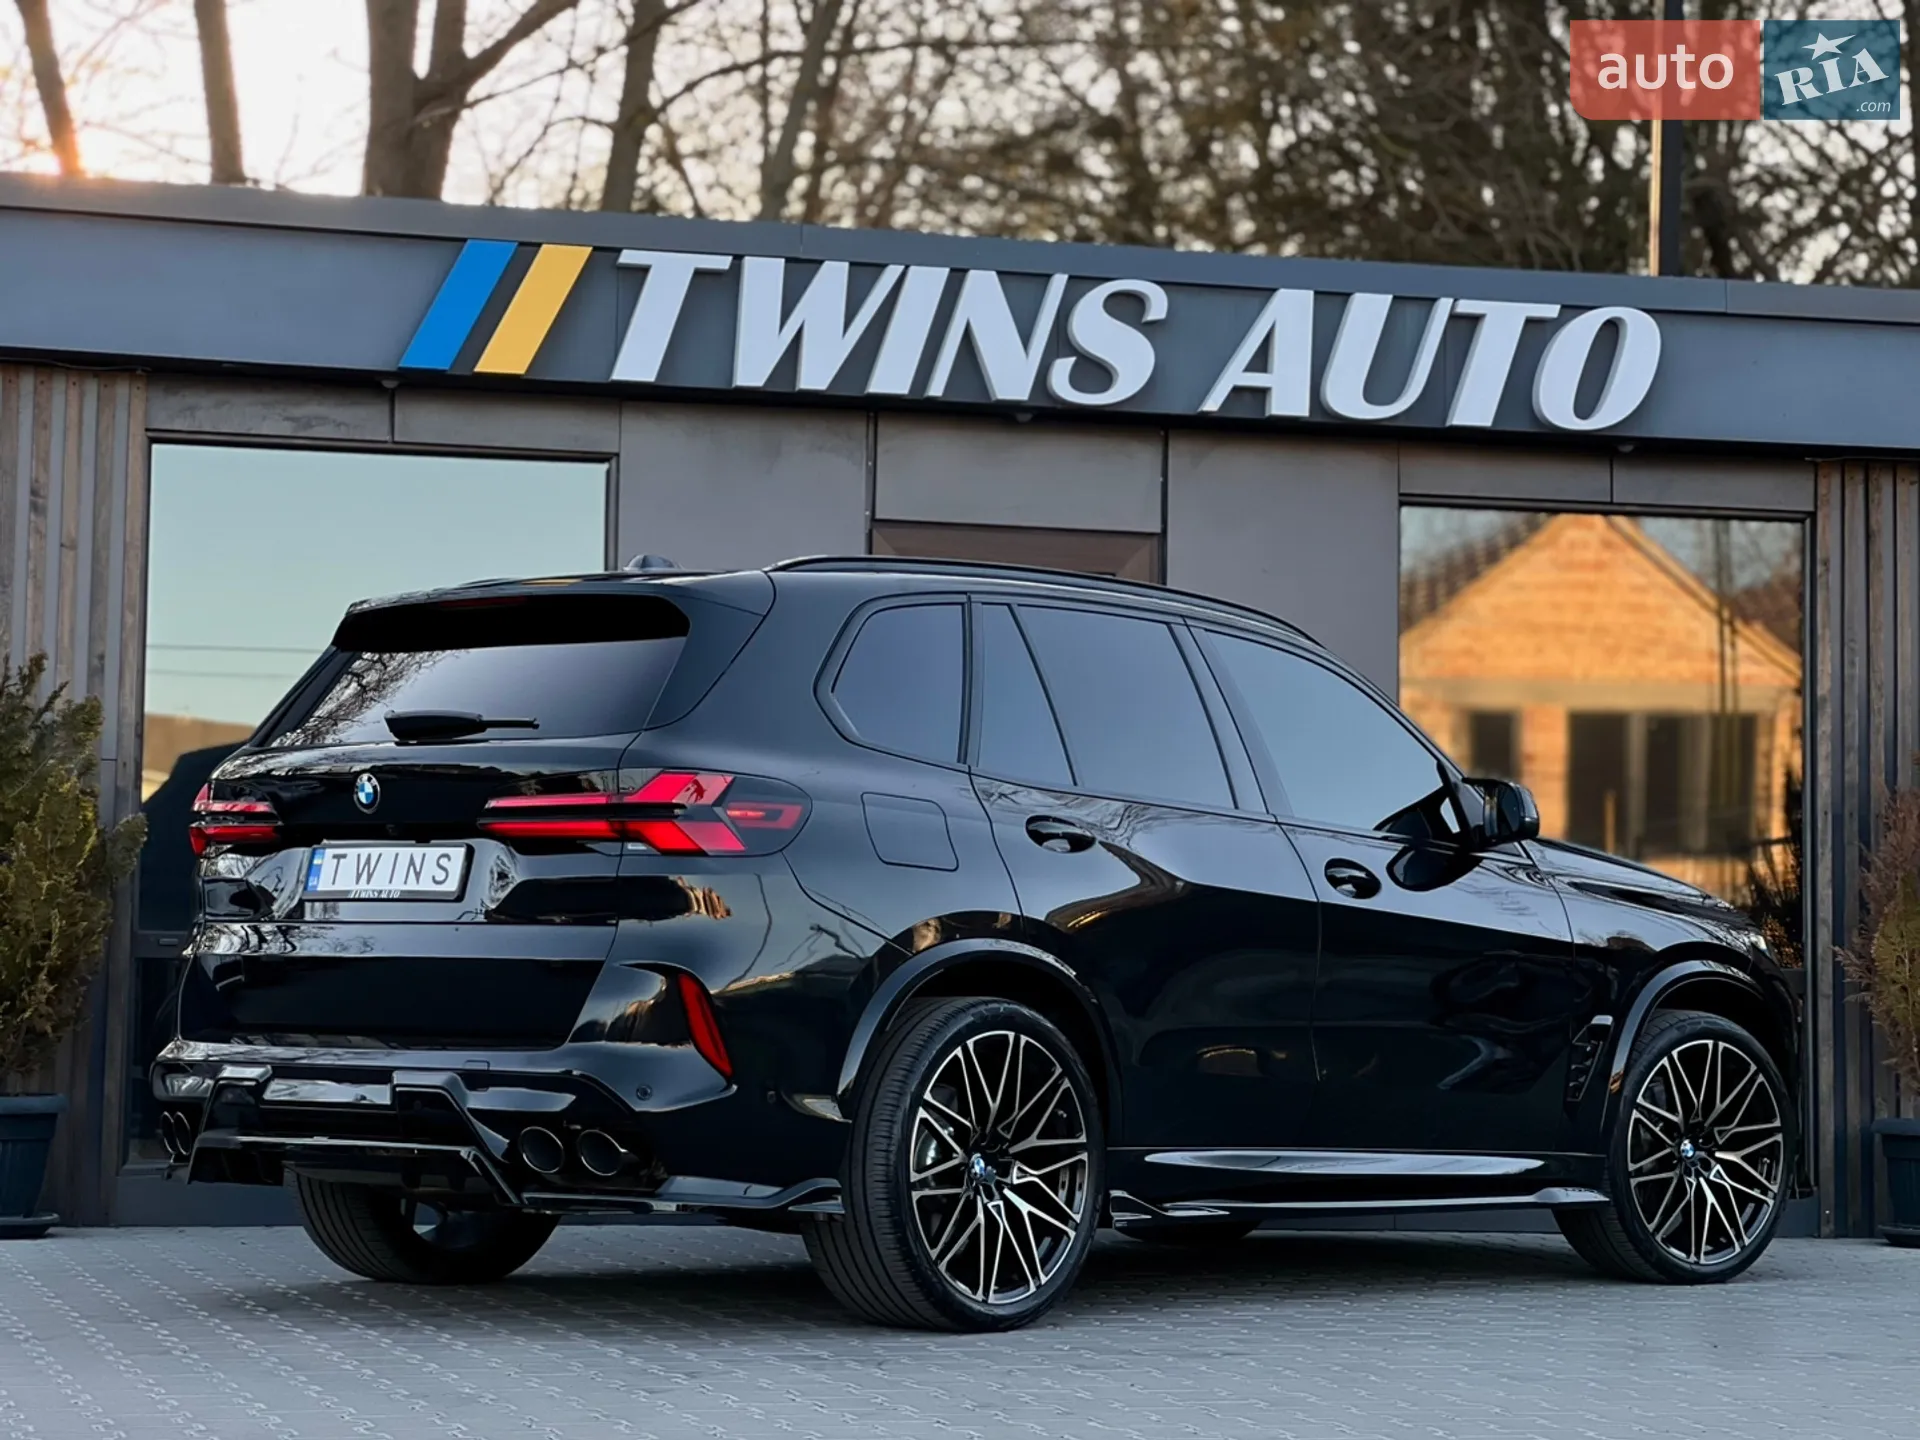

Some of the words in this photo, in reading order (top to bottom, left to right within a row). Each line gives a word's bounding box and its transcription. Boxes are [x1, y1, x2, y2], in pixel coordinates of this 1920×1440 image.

[609, 249, 1169, 406] TWINS
[1197, 288, 1662, 431] AUTO
[331, 852, 452, 886] TWINS
